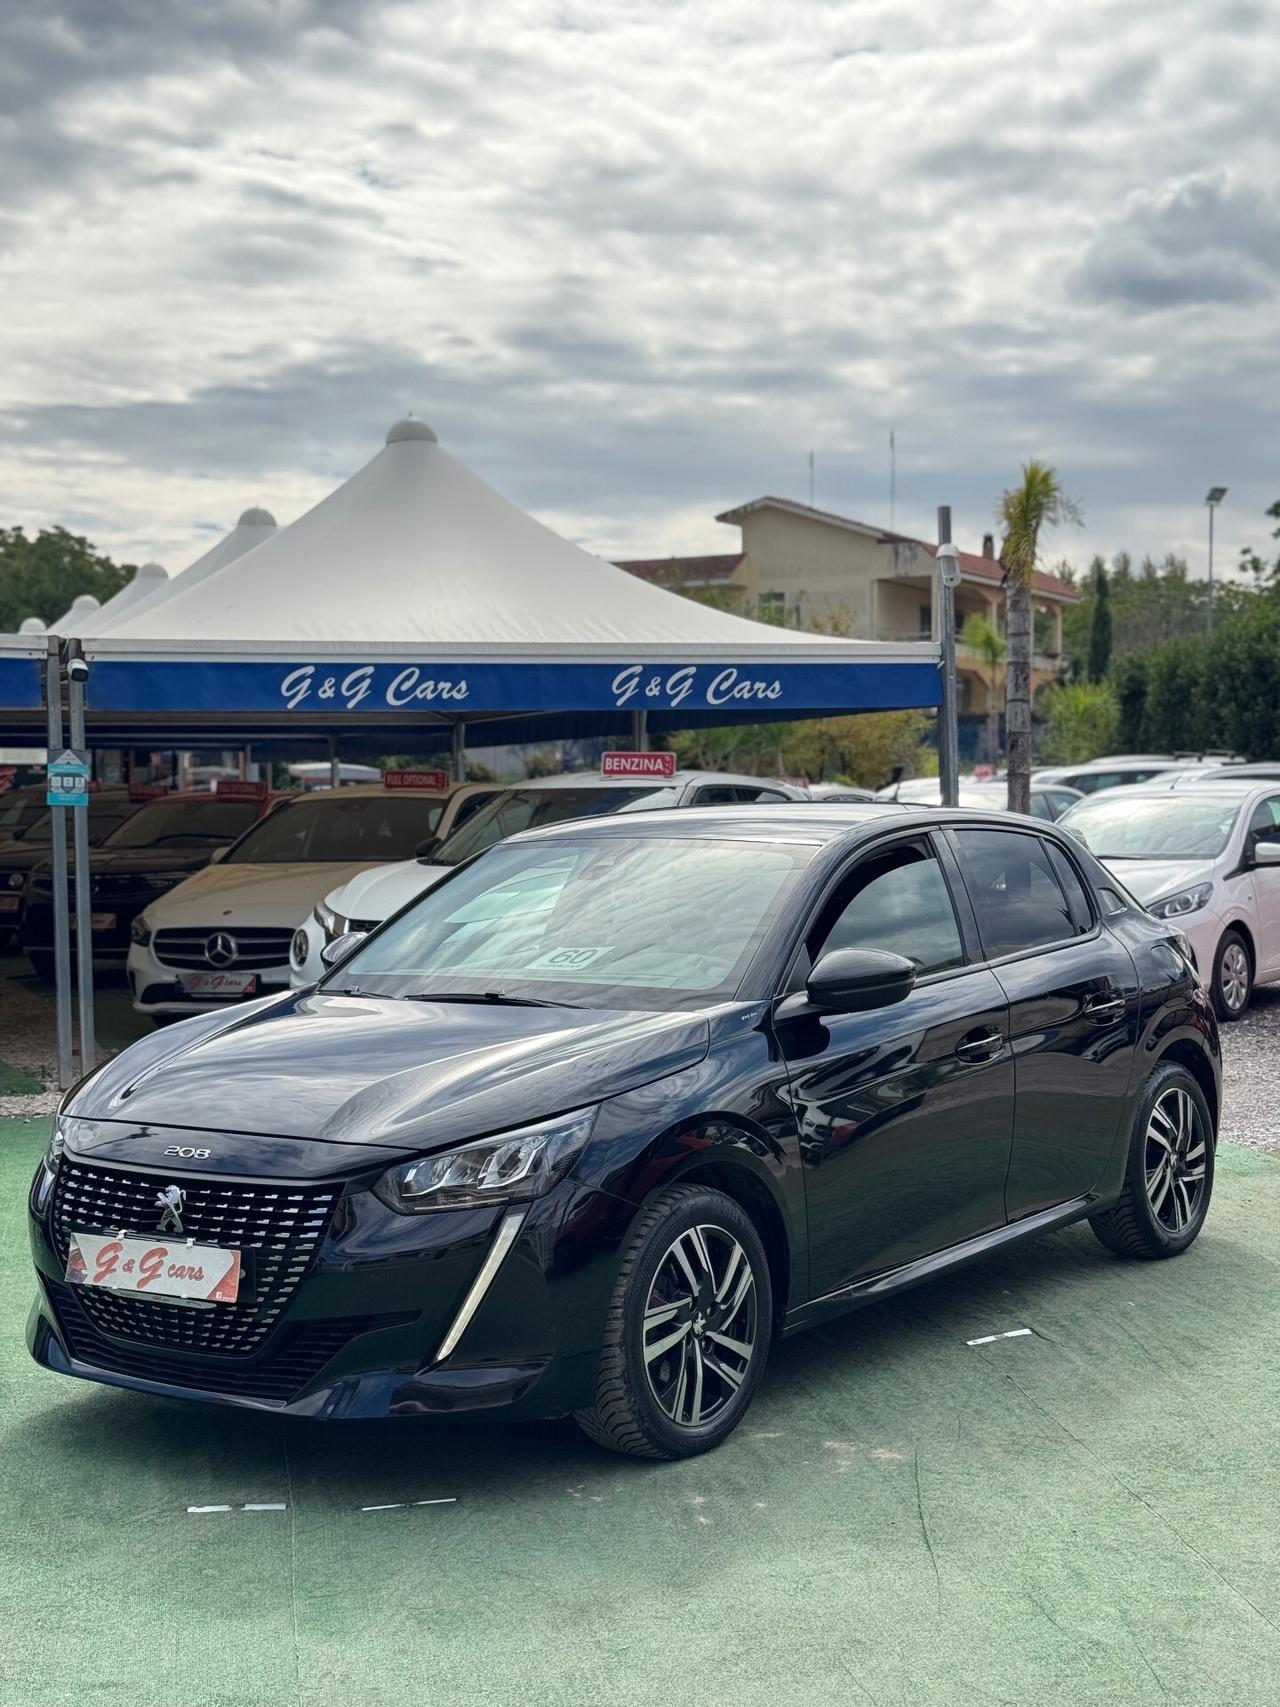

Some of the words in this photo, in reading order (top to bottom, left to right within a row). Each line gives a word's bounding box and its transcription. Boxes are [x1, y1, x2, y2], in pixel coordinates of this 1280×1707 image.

[386, 667, 469, 706] Cars
[706, 668, 783, 705] Cars
[605, 757, 664, 771] BENZINA
[387, 774, 402, 785] FULL
[403, 774, 437, 786] OPTIONAL
[548, 949, 599, 964] 60
[164, 1145, 211, 1160] 208
[167, 1263, 204, 1281] cars
